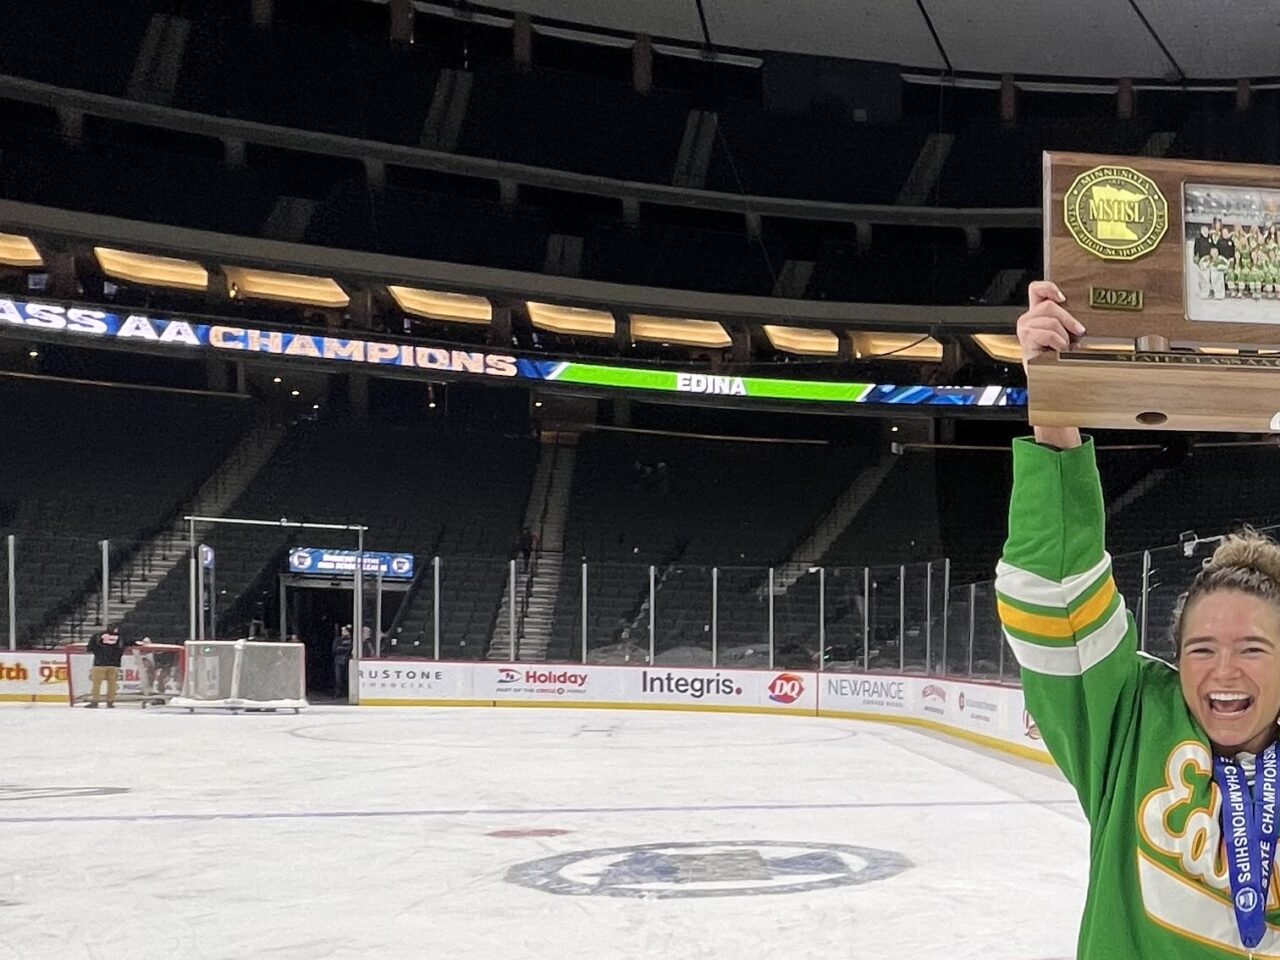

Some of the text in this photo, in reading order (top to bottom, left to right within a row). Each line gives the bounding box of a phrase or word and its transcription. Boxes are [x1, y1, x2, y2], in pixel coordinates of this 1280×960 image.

[1096, 290, 1137, 307] 2024
[117, 314, 201, 346] AA
[208, 325, 518, 377] CHAMPIONS
[676, 372, 747, 396] EDINA
[525, 671, 589, 687] Holiday
[642, 671, 743, 698] Integris.
[775, 679, 801, 698] DQ
[828, 679, 905, 700] NEWRANGE
[1224, 765, 1252, 884] CHAMPIONSHIPS
